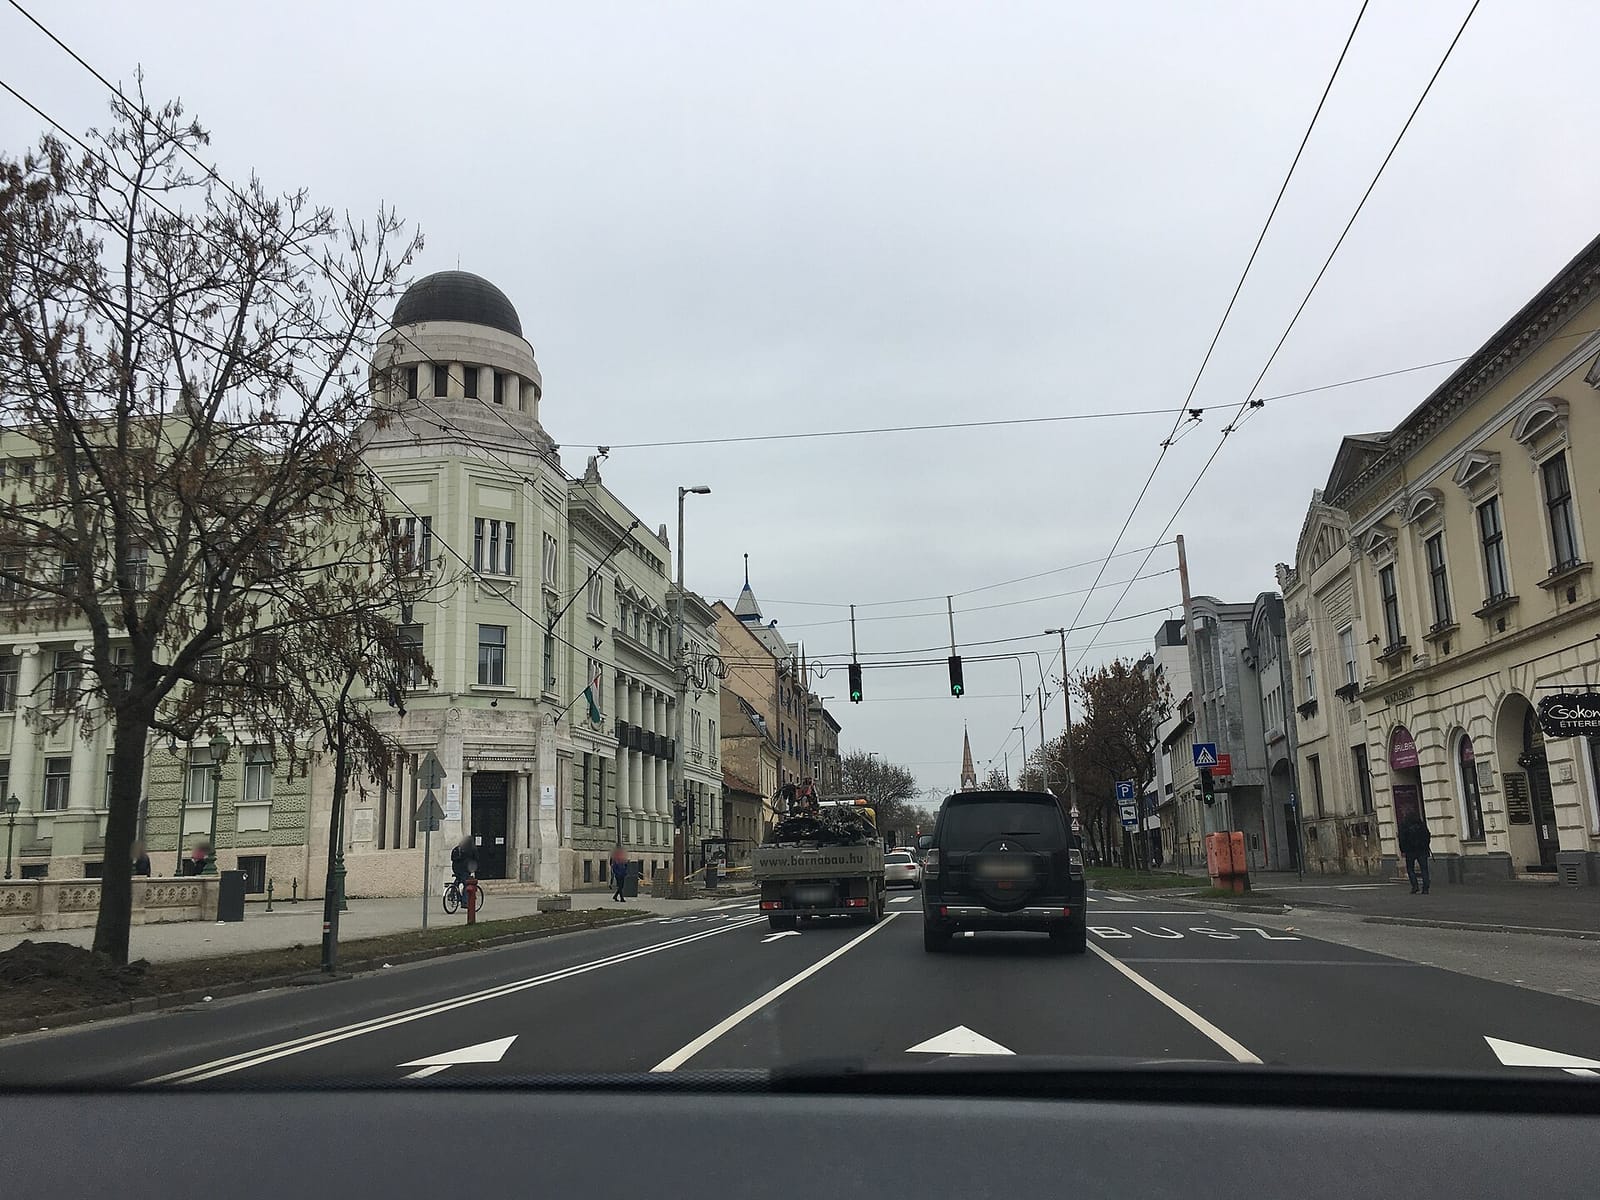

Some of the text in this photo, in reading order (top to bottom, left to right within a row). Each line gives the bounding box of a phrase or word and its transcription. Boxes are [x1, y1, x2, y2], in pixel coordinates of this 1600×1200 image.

[1560, 719, 1600, 728] ÉTTERE
[760, 853, 864, 867] www.barnabau.hu
[1086, 926, 1302, 940] BUSZ
